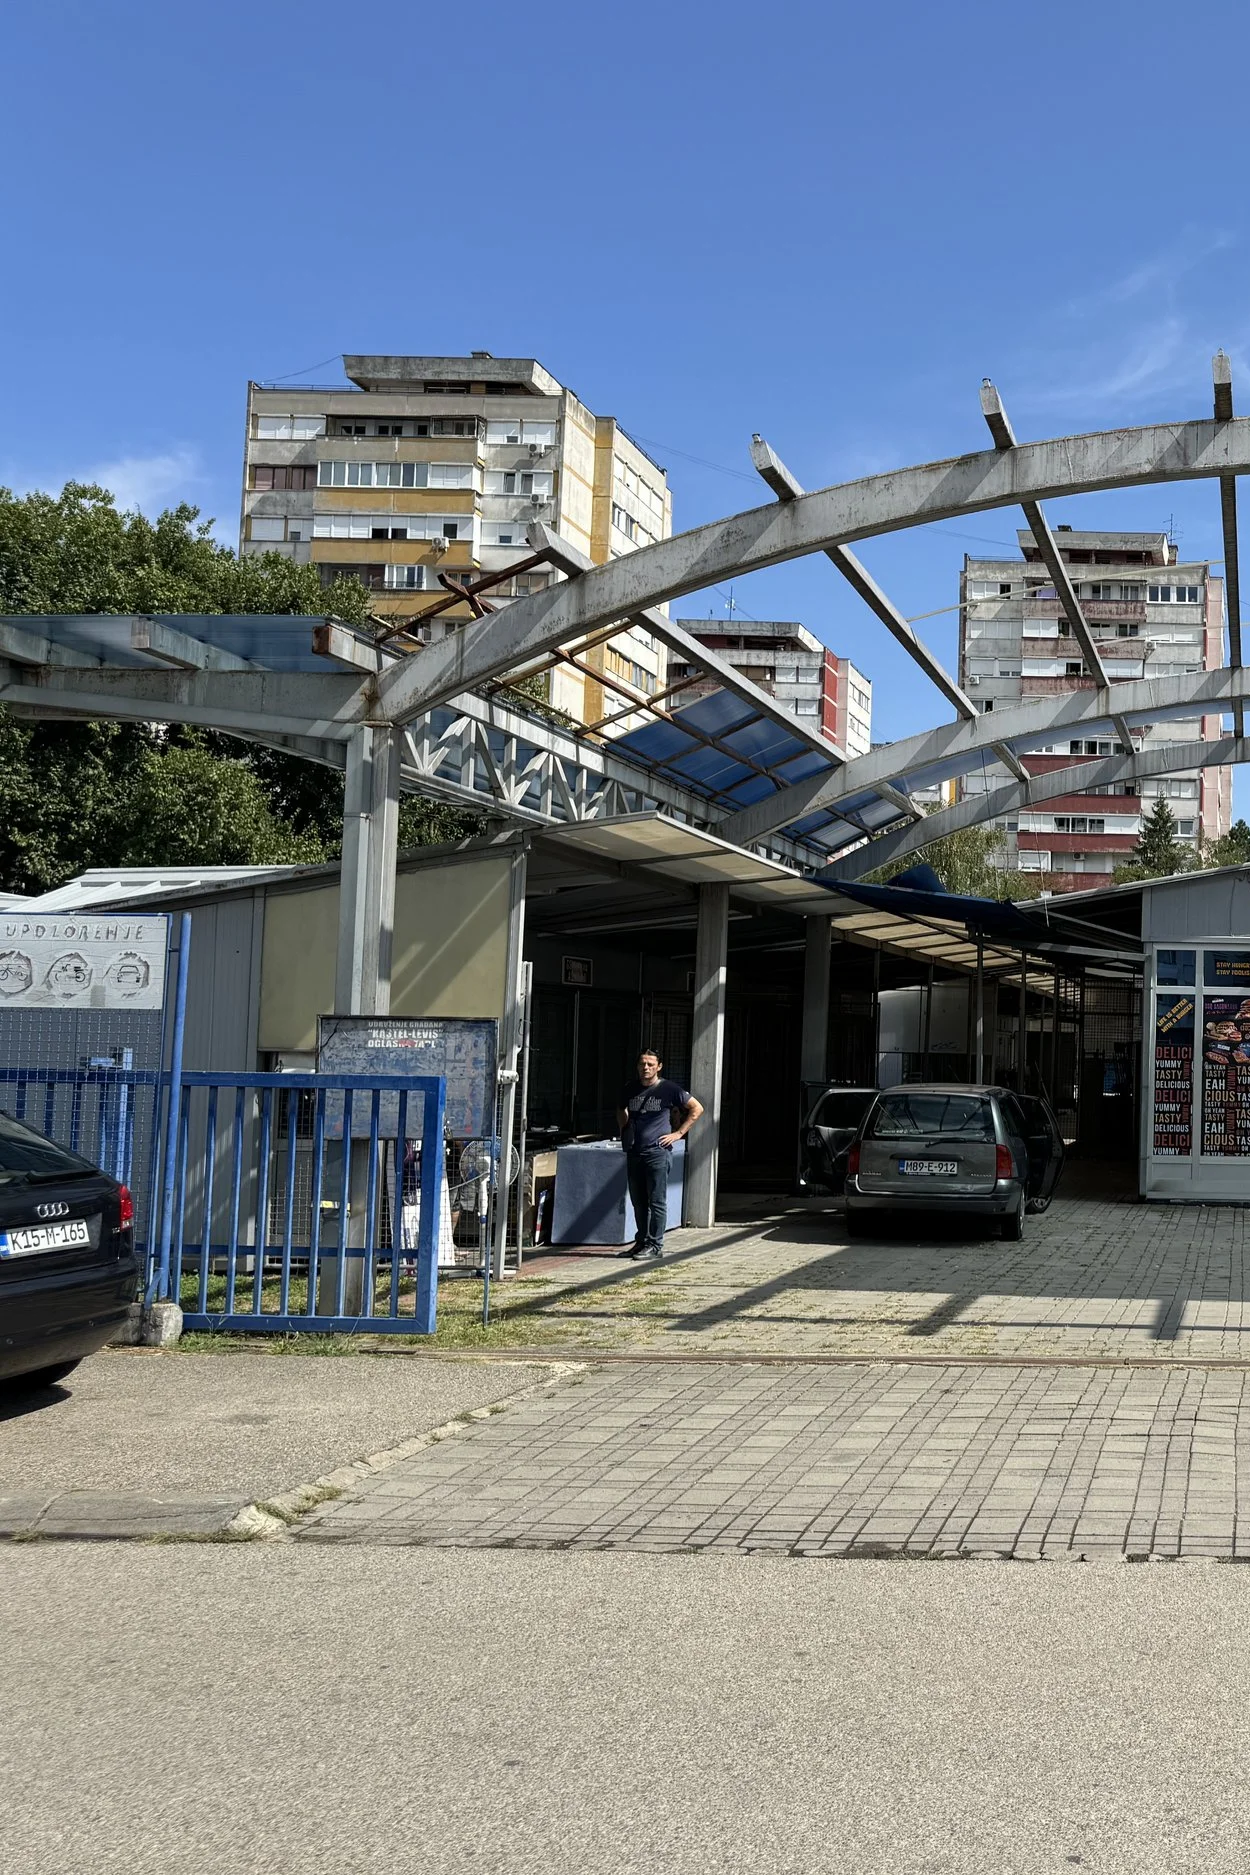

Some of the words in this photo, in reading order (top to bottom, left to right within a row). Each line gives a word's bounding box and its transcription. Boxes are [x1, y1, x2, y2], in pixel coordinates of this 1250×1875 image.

[1156, 1060, 1181, 1068] YUMMY
[1156, 1070, 1182, 1079] TASTY
[1156, 1081, 1190, 1089] DELICIOUS
[1206, 1079, 1225, 1090] EAH
[1205, 1091, 1235, 1101] CIOUS
[1155, 1103, 1180, 1112] YUMMY
[1155, 1113, 1181, 1123] TASTY
[1155, 1124, 1189, 1133] DELICIOUS
[1205, 1122, 1225, 1133] EAH
[1204, 1134, 1235, 1145] CIOUS
[905, 1162, 956, 1173] M89-E-912
[11, 1222, 85, 1251] K15-M-165
